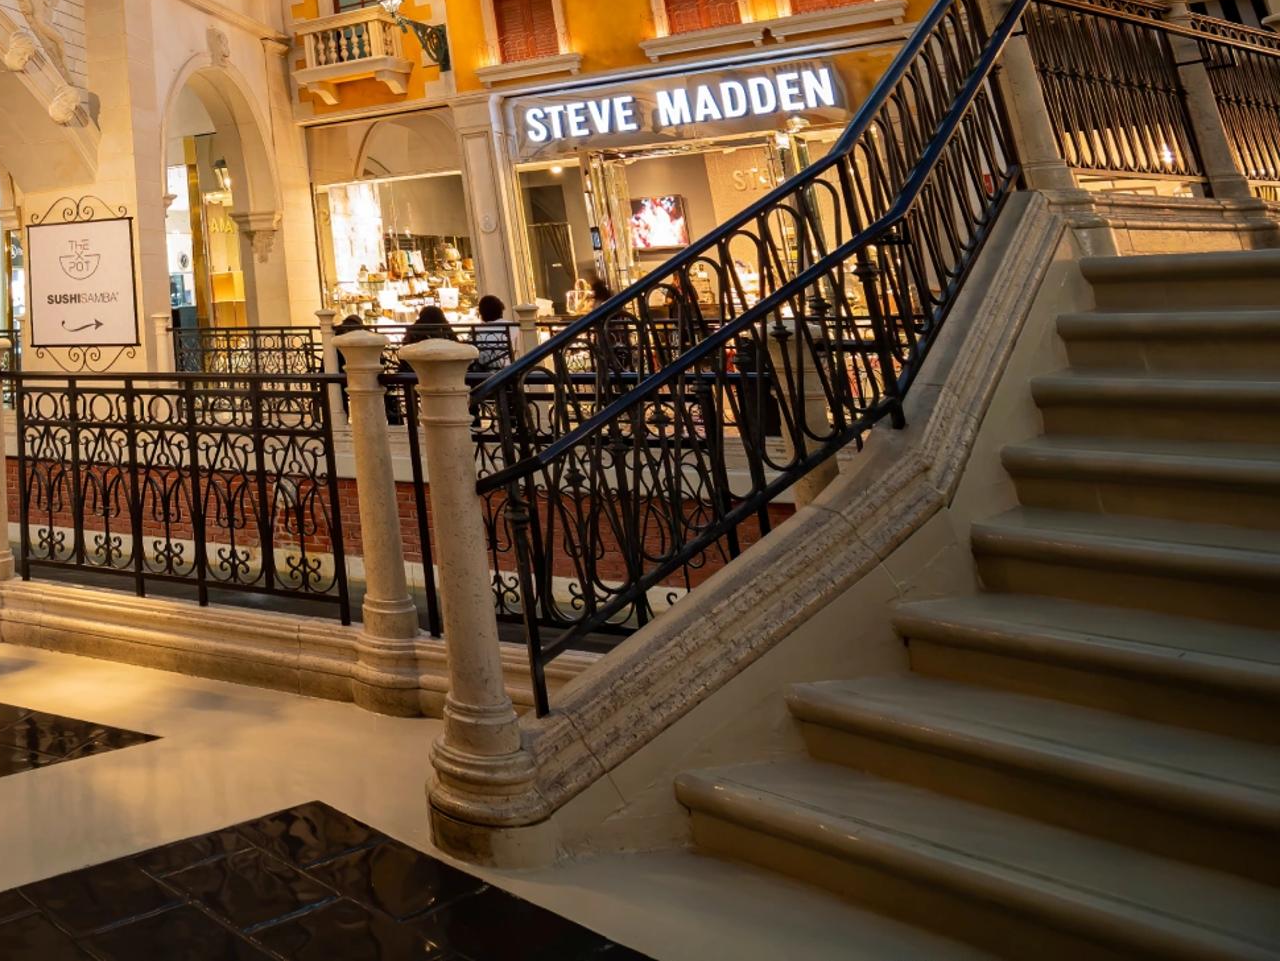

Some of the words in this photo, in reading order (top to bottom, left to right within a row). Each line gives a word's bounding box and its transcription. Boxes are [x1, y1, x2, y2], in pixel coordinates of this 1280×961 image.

[526, 96, 638, 142] STEVE
[656, 68, 835, 127] MADDEN
[68, 239, 90, 251] THE
[75, 251, 84, 260] X
[69, 261, 90, 272] POT
[47, 292, 118, 305] SUSHISAMBA
